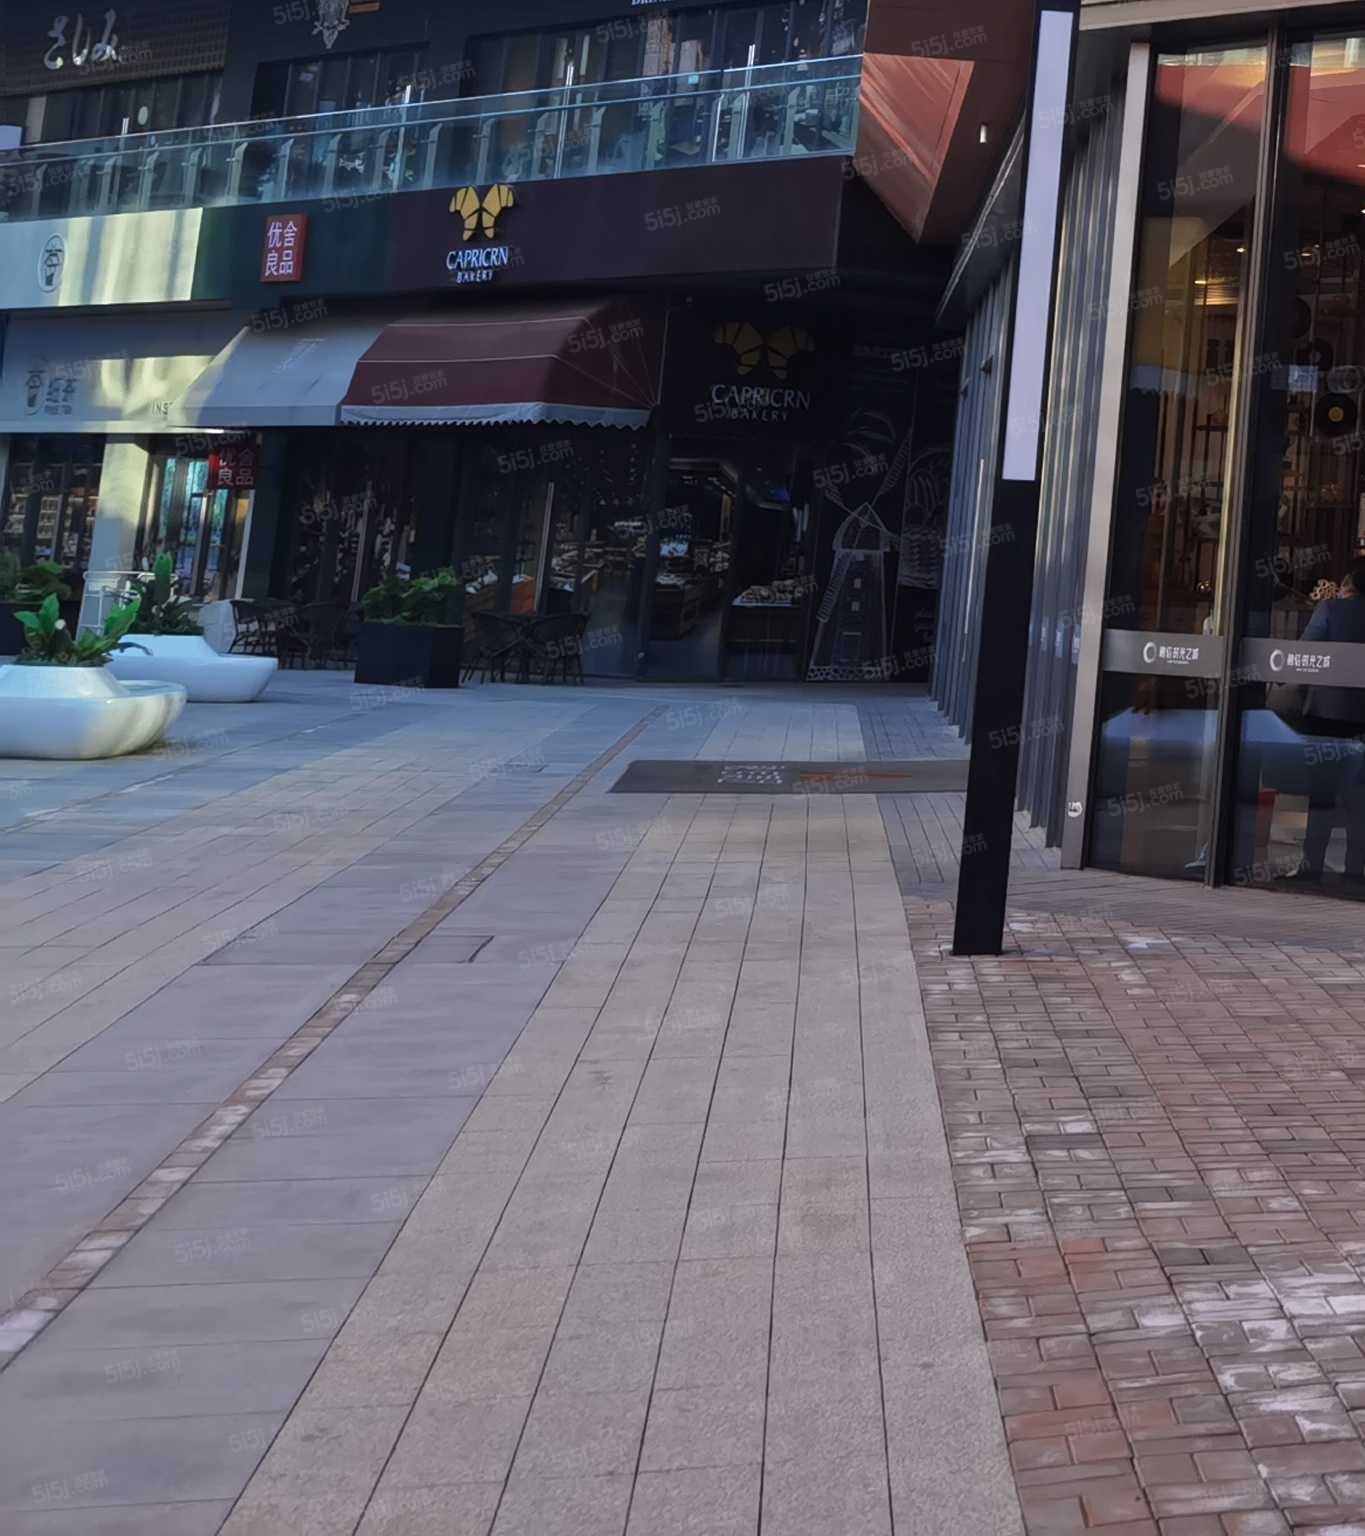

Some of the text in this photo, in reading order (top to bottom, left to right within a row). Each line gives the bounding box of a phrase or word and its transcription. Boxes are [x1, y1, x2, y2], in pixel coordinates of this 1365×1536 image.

[265, 250, 294, 277] 良品
[447, 246, 508, 270] CAPRICRN
[456, 269, 493, 284] BAKERY
[711, 384, 811, 409] CAPRICRN
[731, 407, 788, 422] BAKERY
